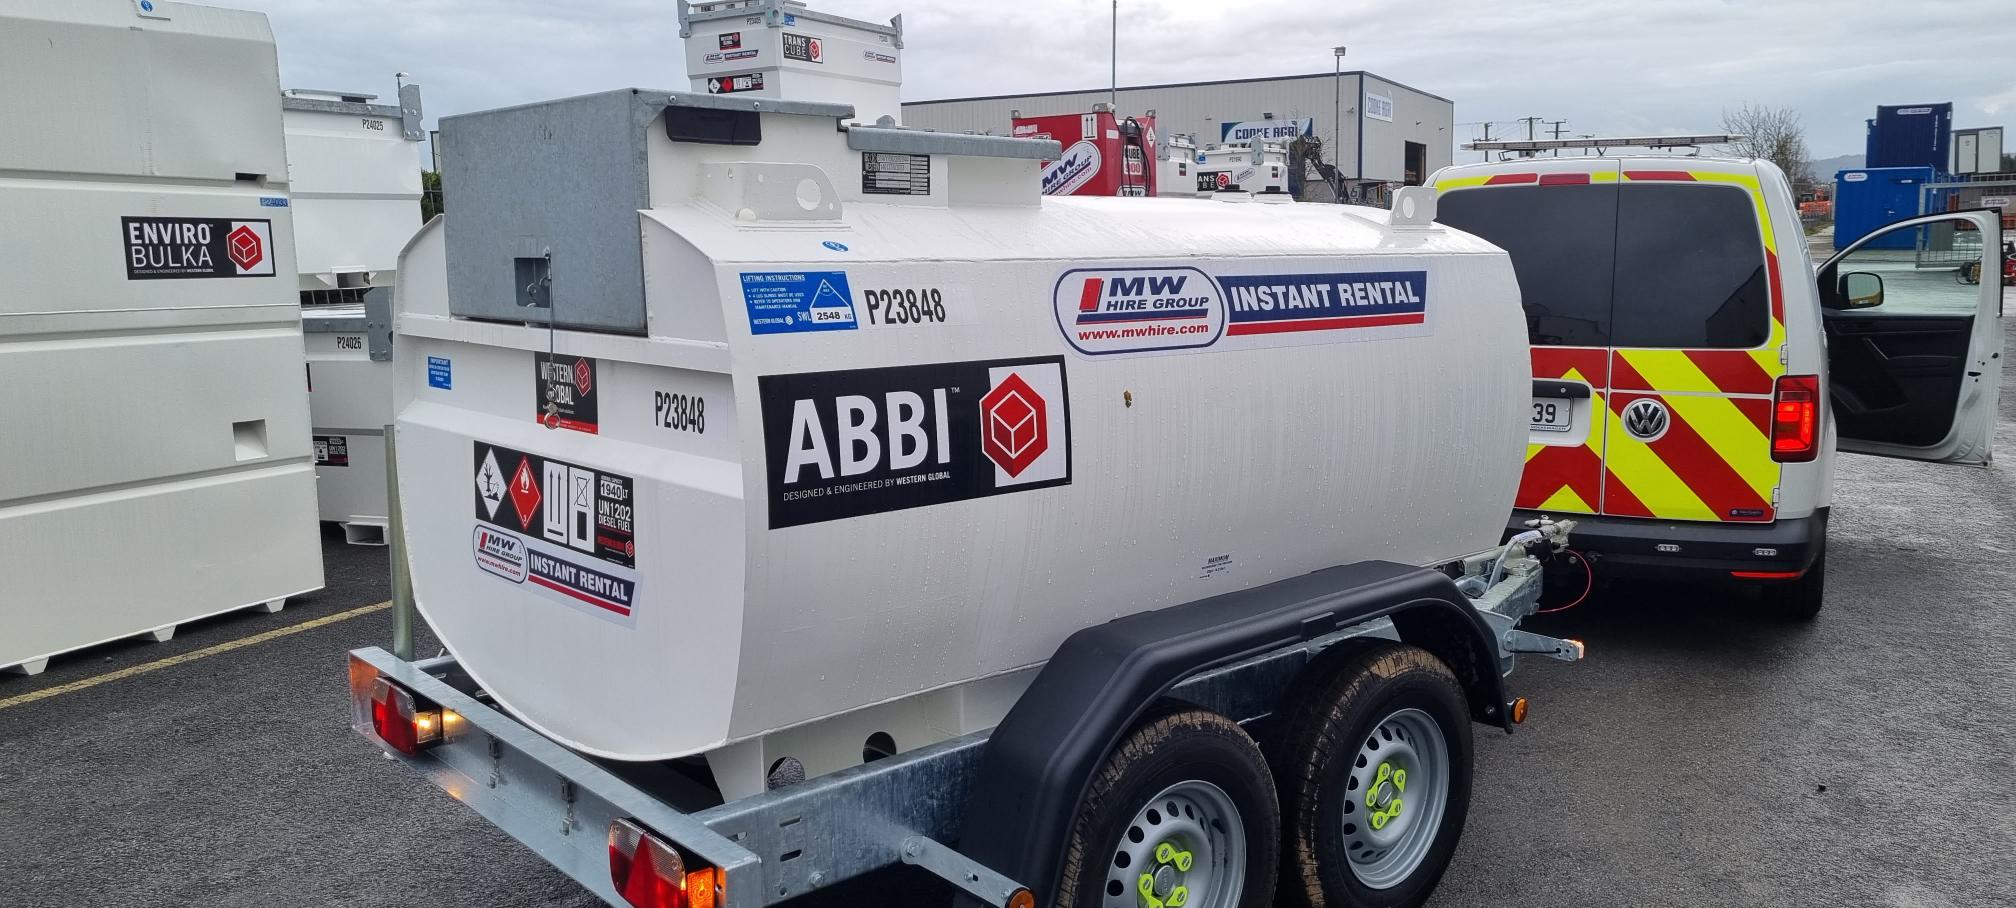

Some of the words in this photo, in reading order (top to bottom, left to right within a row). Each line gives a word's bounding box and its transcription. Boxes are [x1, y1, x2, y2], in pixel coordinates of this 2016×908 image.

[784, 34, 806, 47] TRANS
[784, 44, 806, 57] CUBE
[362, 118, 384, 130] P24025
[1235, 127, 1270, 140] COOKE
[1273, 126, 1298, 138] AGRI
[128, 222, 211, 245] ENVIRO
[132, 246, 214, 268] BULKA
[742, 274, 765, 282] LIFTING
[766, 274, 806, 282] INSTRUCTIONS
[1108, 276, 1188, 298] MW
[1106, 299, 1148, 312] HIRE
[1152, 296, 1210, 310] GROUP
[1230, 283, 1331, 312] INSTANT
[1337, 281, 1420, 307] RENTAL
[864, 288, 946, 325] P23848
[797, 311, 812, 322] SWL
[816, 311, 840, 320] 2548
[1078, 324, 1209, 341] www.mwhire.com
[336, 336, 362, 350] P24026
[654, 390, 706, 436] P23848
[783, 388, 951, 485] ABBI
[601, 482, 622, 499] 1940
[622, 488, 629, 499] LT
[783, 488, 825, 502] DESIGNED
[826, 486, 832, 496] &
[834, 480, 884, 495] ENGINEERED
[884, 479, 895, 488] BY
[896, 474, 927, 486] WESTERN
[928, 471, 951, 482] GLOBAL
[598, 498, 632, 522] UN1202
[598, 514, 617, 529] DIESEL
[617, 520, 632, 533] FUEL
[488, 534, 516, 551] MW
[501, 551, 522, 562] GROUP
[530, 554, 577, 584] INSTANT
[580, 570, 628, 601] RENTAL
